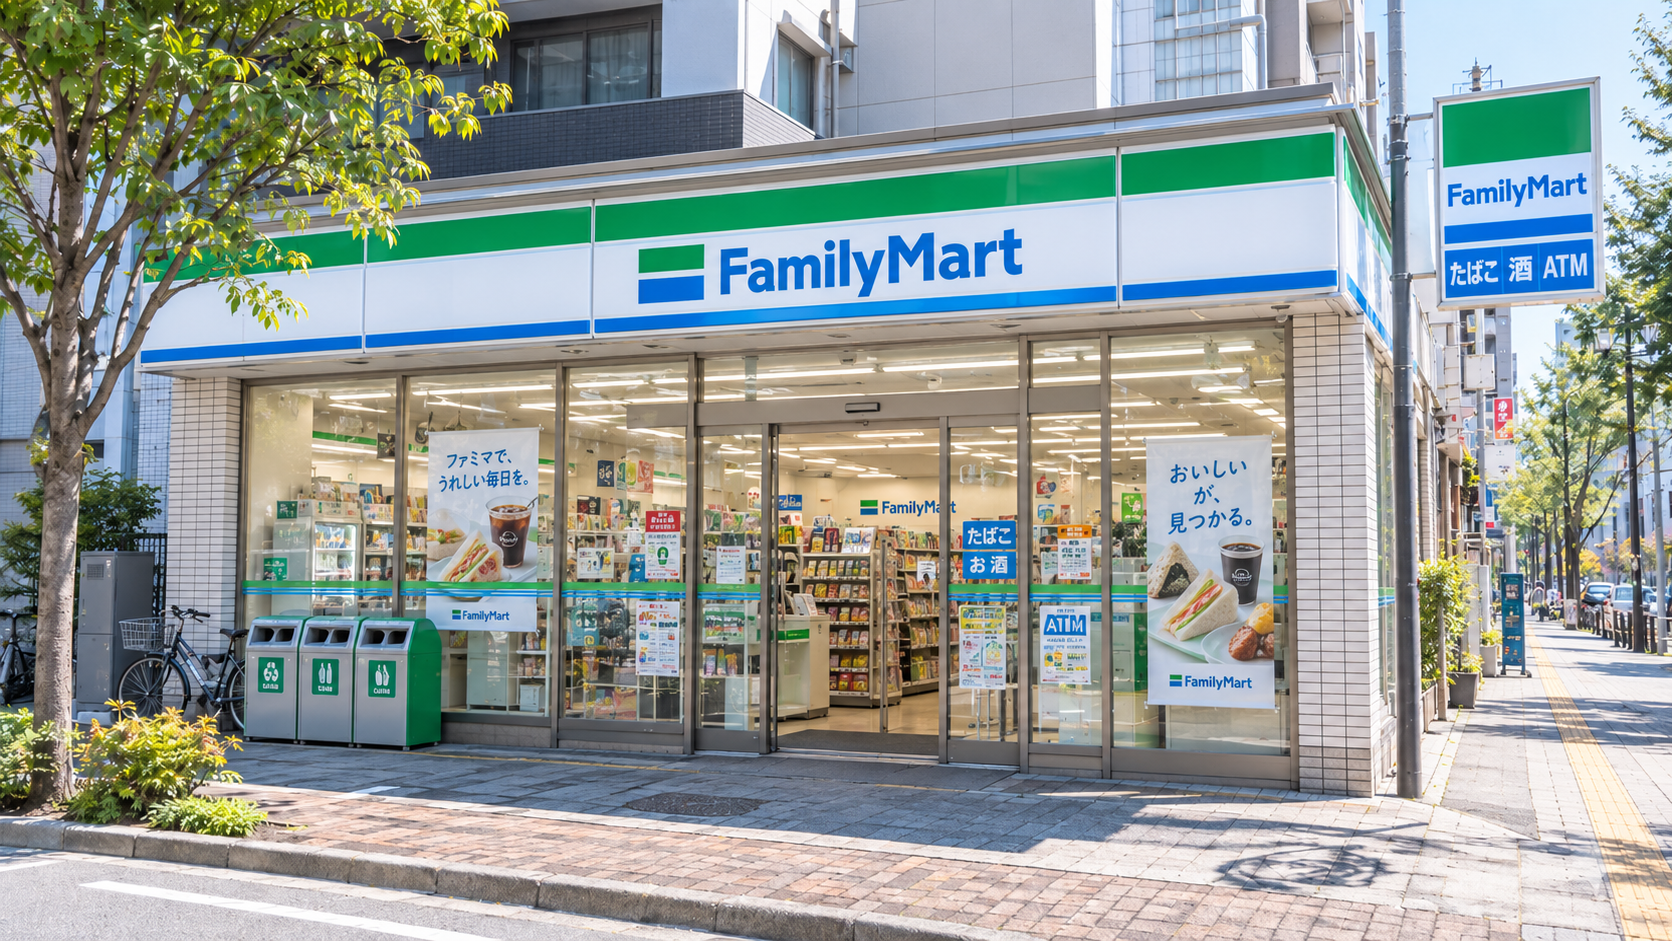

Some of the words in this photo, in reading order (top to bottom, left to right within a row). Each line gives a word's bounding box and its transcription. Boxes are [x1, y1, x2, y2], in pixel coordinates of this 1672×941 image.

[1447, 172, 1588, 208] FamilyMart
[719, 228, 1024, 298] FamilyMart
[1450, 259, 1499, 286] たばこ
[1508, 255, 1533, 283] 酒
[1543, 252, 1588, 279] ATM
[446, 448, 512, 469] ファミマで、
[438, 469, 529, 492] うれしい毎日を。
[1170, 460, 1247, 484] おいしい
[1194, 484, 1220, 505] が、
[882, 499, 957, 518] FamilyMat
[1168, 507, 1253, 535] 見つかる。
[967, 526, 1012, 545] たばこ
[969, 555, 1009, 574] お酒
[462, 609, 510, 624] FamilyMart
[1184, 674, 1253, 691] FamilyMart
